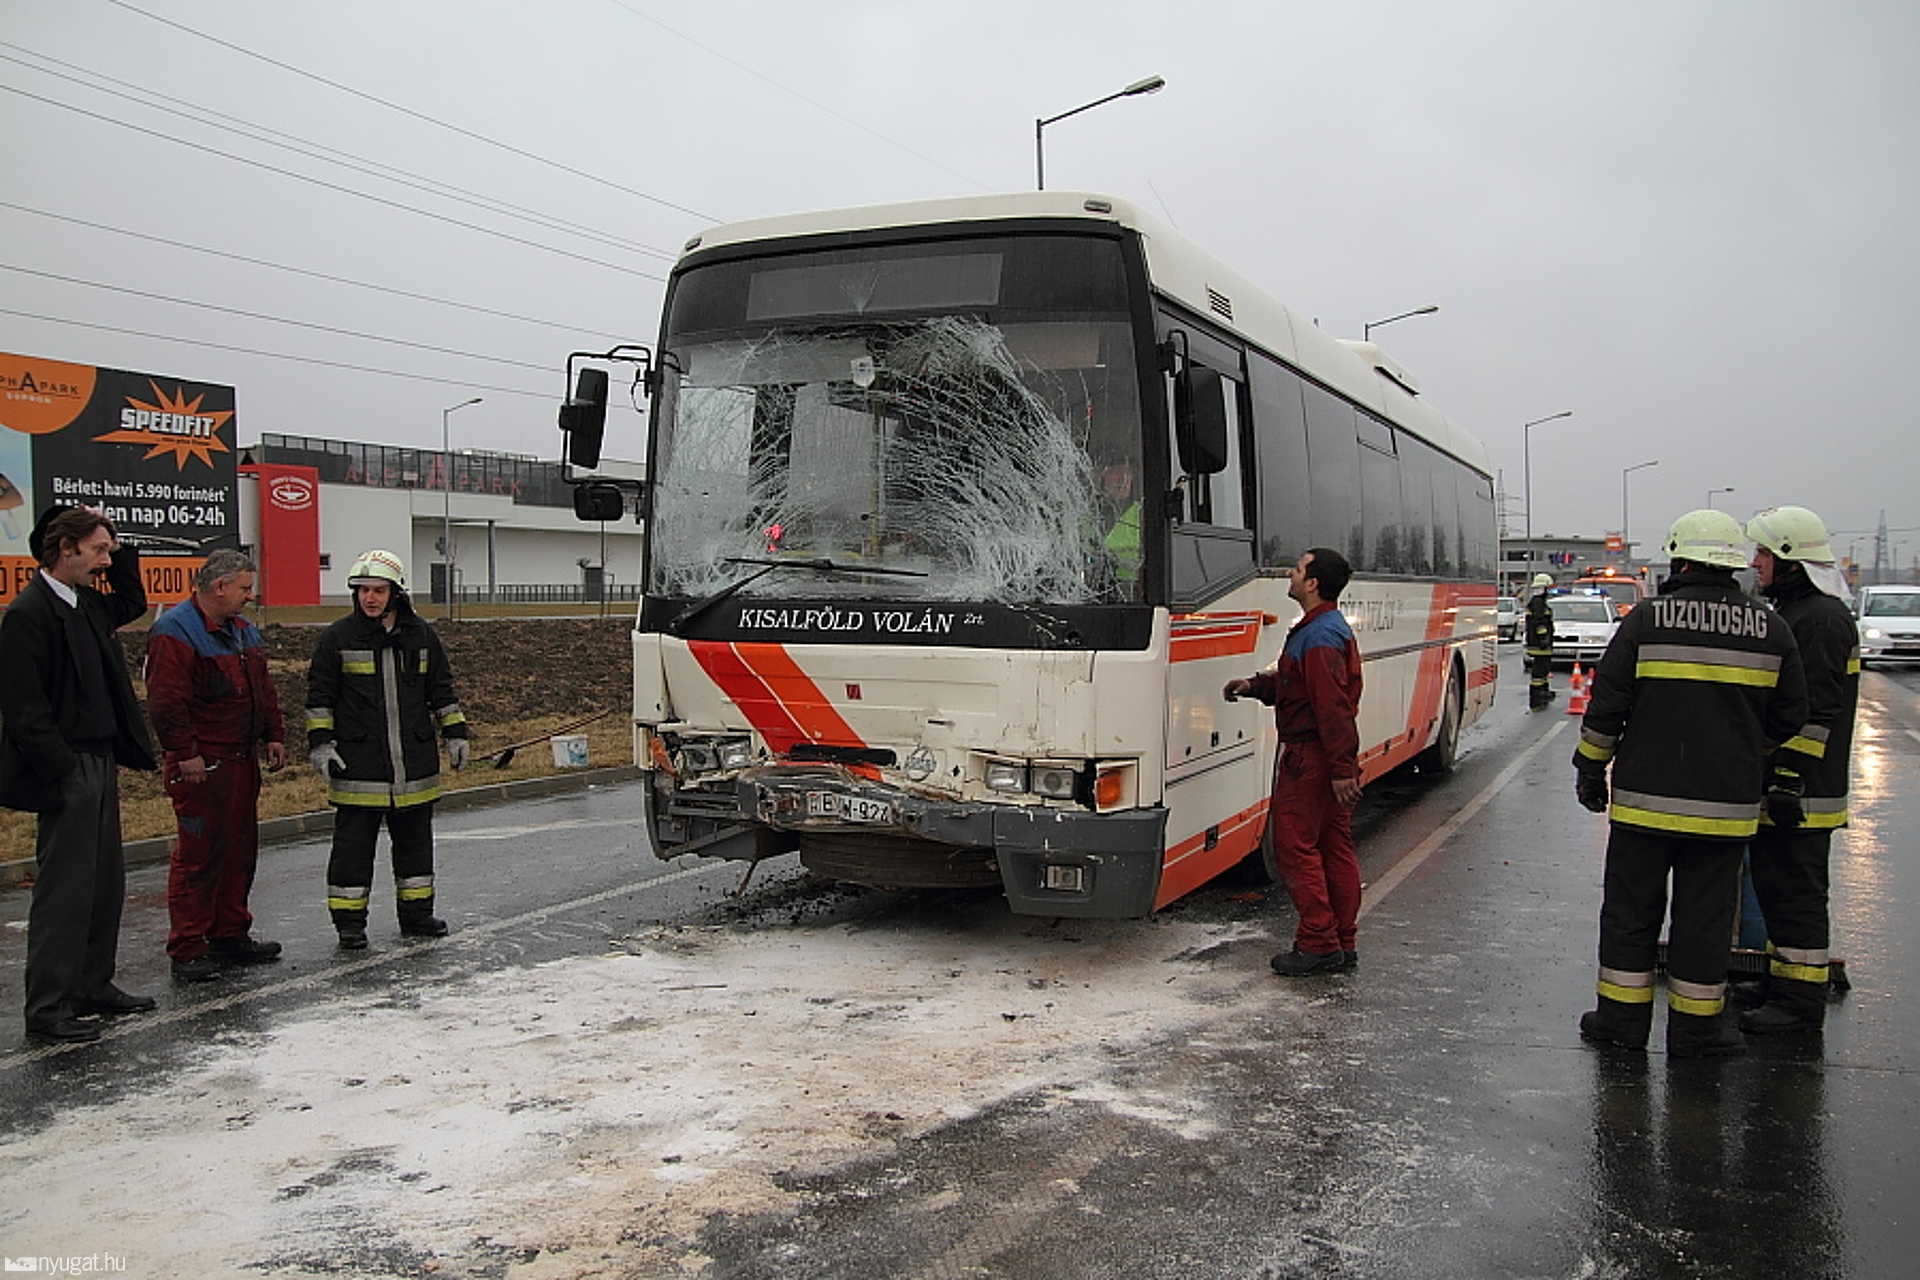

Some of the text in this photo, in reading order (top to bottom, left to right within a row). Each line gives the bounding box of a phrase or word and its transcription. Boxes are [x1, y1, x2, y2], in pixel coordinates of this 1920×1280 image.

[120, 407, 215, 437] SPEEDFIT
[52, 477, 101, 497] Bérlet:
[103, 479, 134, 498] havi
[135, 483, 171, 500] 5.990
[131, 506, 165, 528] nap
[168, 504, 226, 526] 06-24h
[146, 567, 182, 594] 1200
[737, 604, 864, 631] KISALFÖLD
[872, 607, 955, 633] VOLÁN
